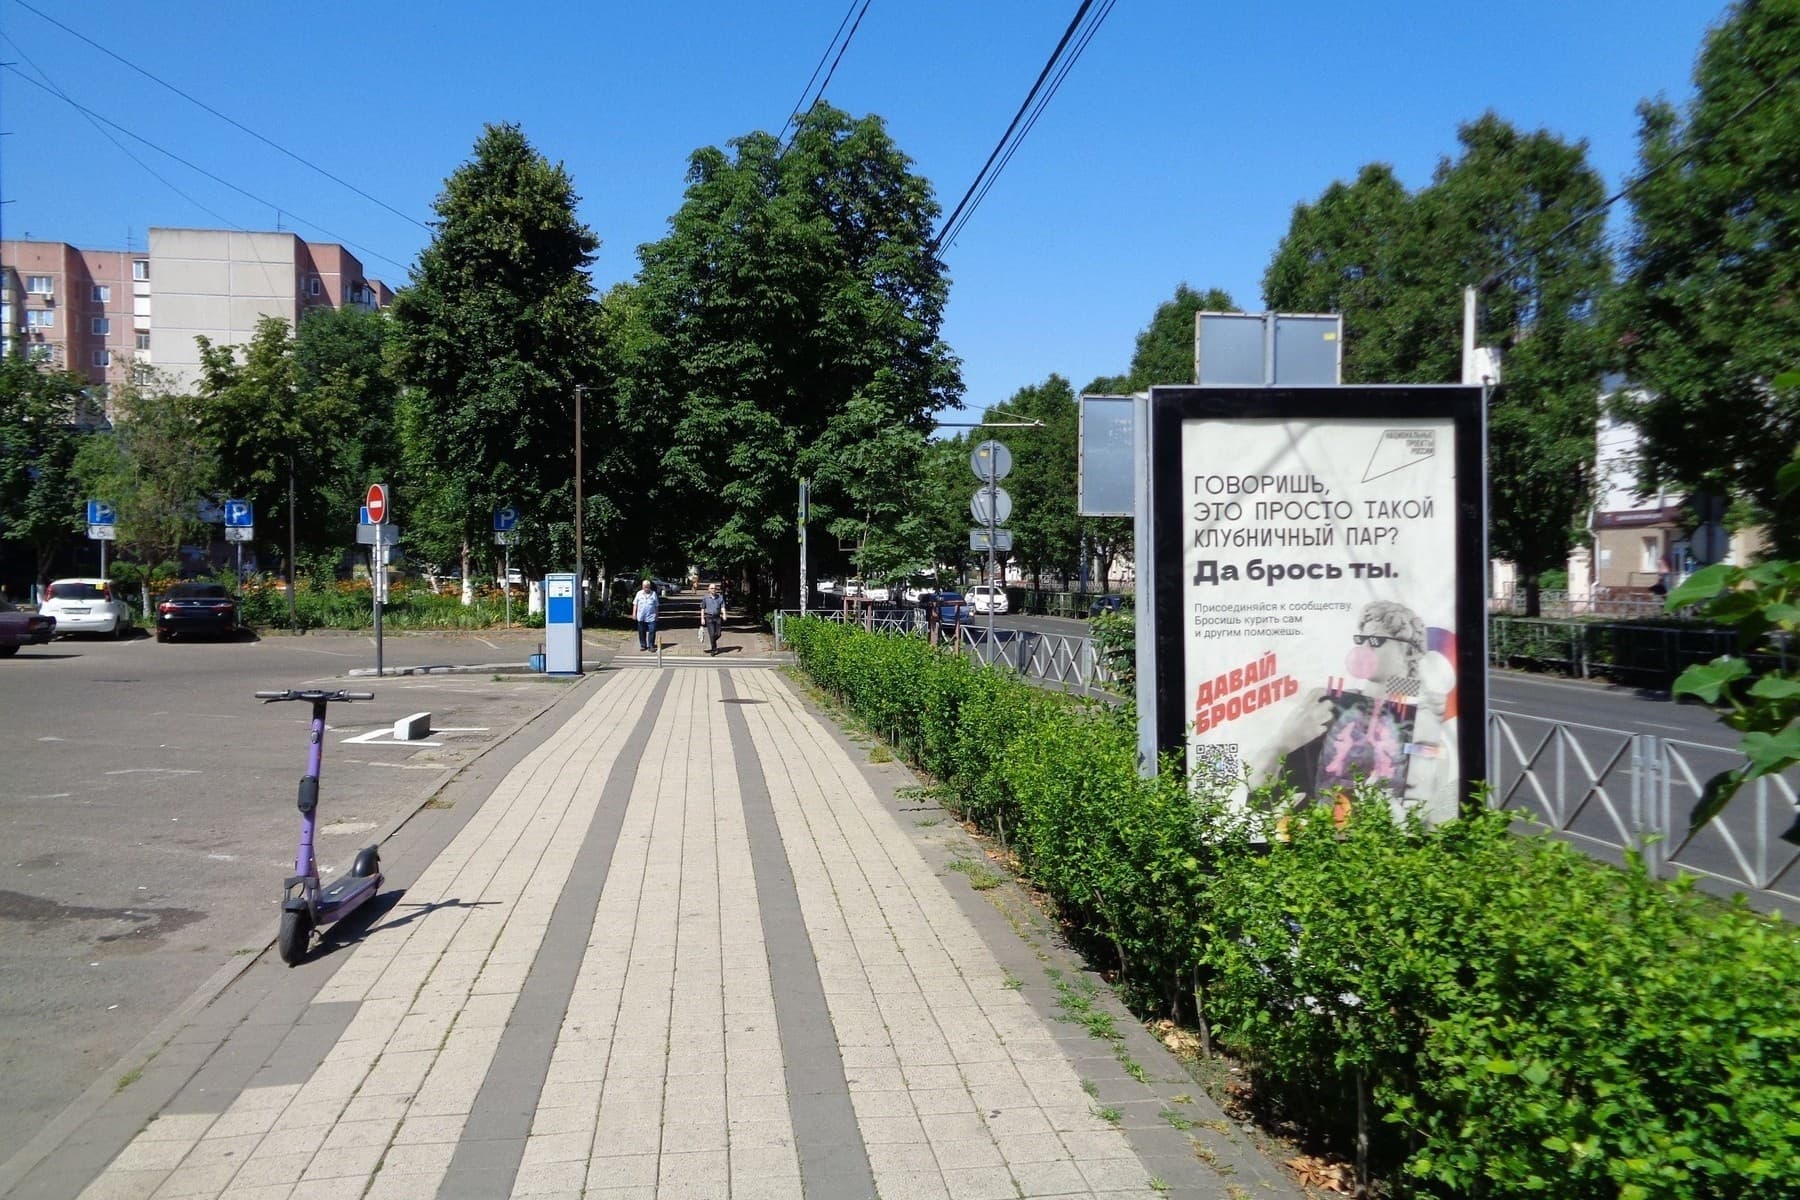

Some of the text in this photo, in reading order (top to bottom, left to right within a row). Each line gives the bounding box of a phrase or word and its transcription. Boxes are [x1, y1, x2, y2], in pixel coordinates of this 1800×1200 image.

[1194, 475, 1330, 496] ГОВОРИШЬ,
[1194, 496, 1434, 521] ЭТО ПРОСТО ТАКОЙ
[1346, 526, 1399, 546] ПАР?
[1193, 559, 1399, 586] Да брось ты.
[1194, 600, 1353, 615] Присоединяйся к сообществу.
[1194, 615, 1303, 627] Бросишь курить сам
[1194, 628, 1304, 640] и другим поможешь.
[1196, 650, 1277, 710] ДАВАЙ
[1195, 674, 1299, 736] БРОСАТЬ
